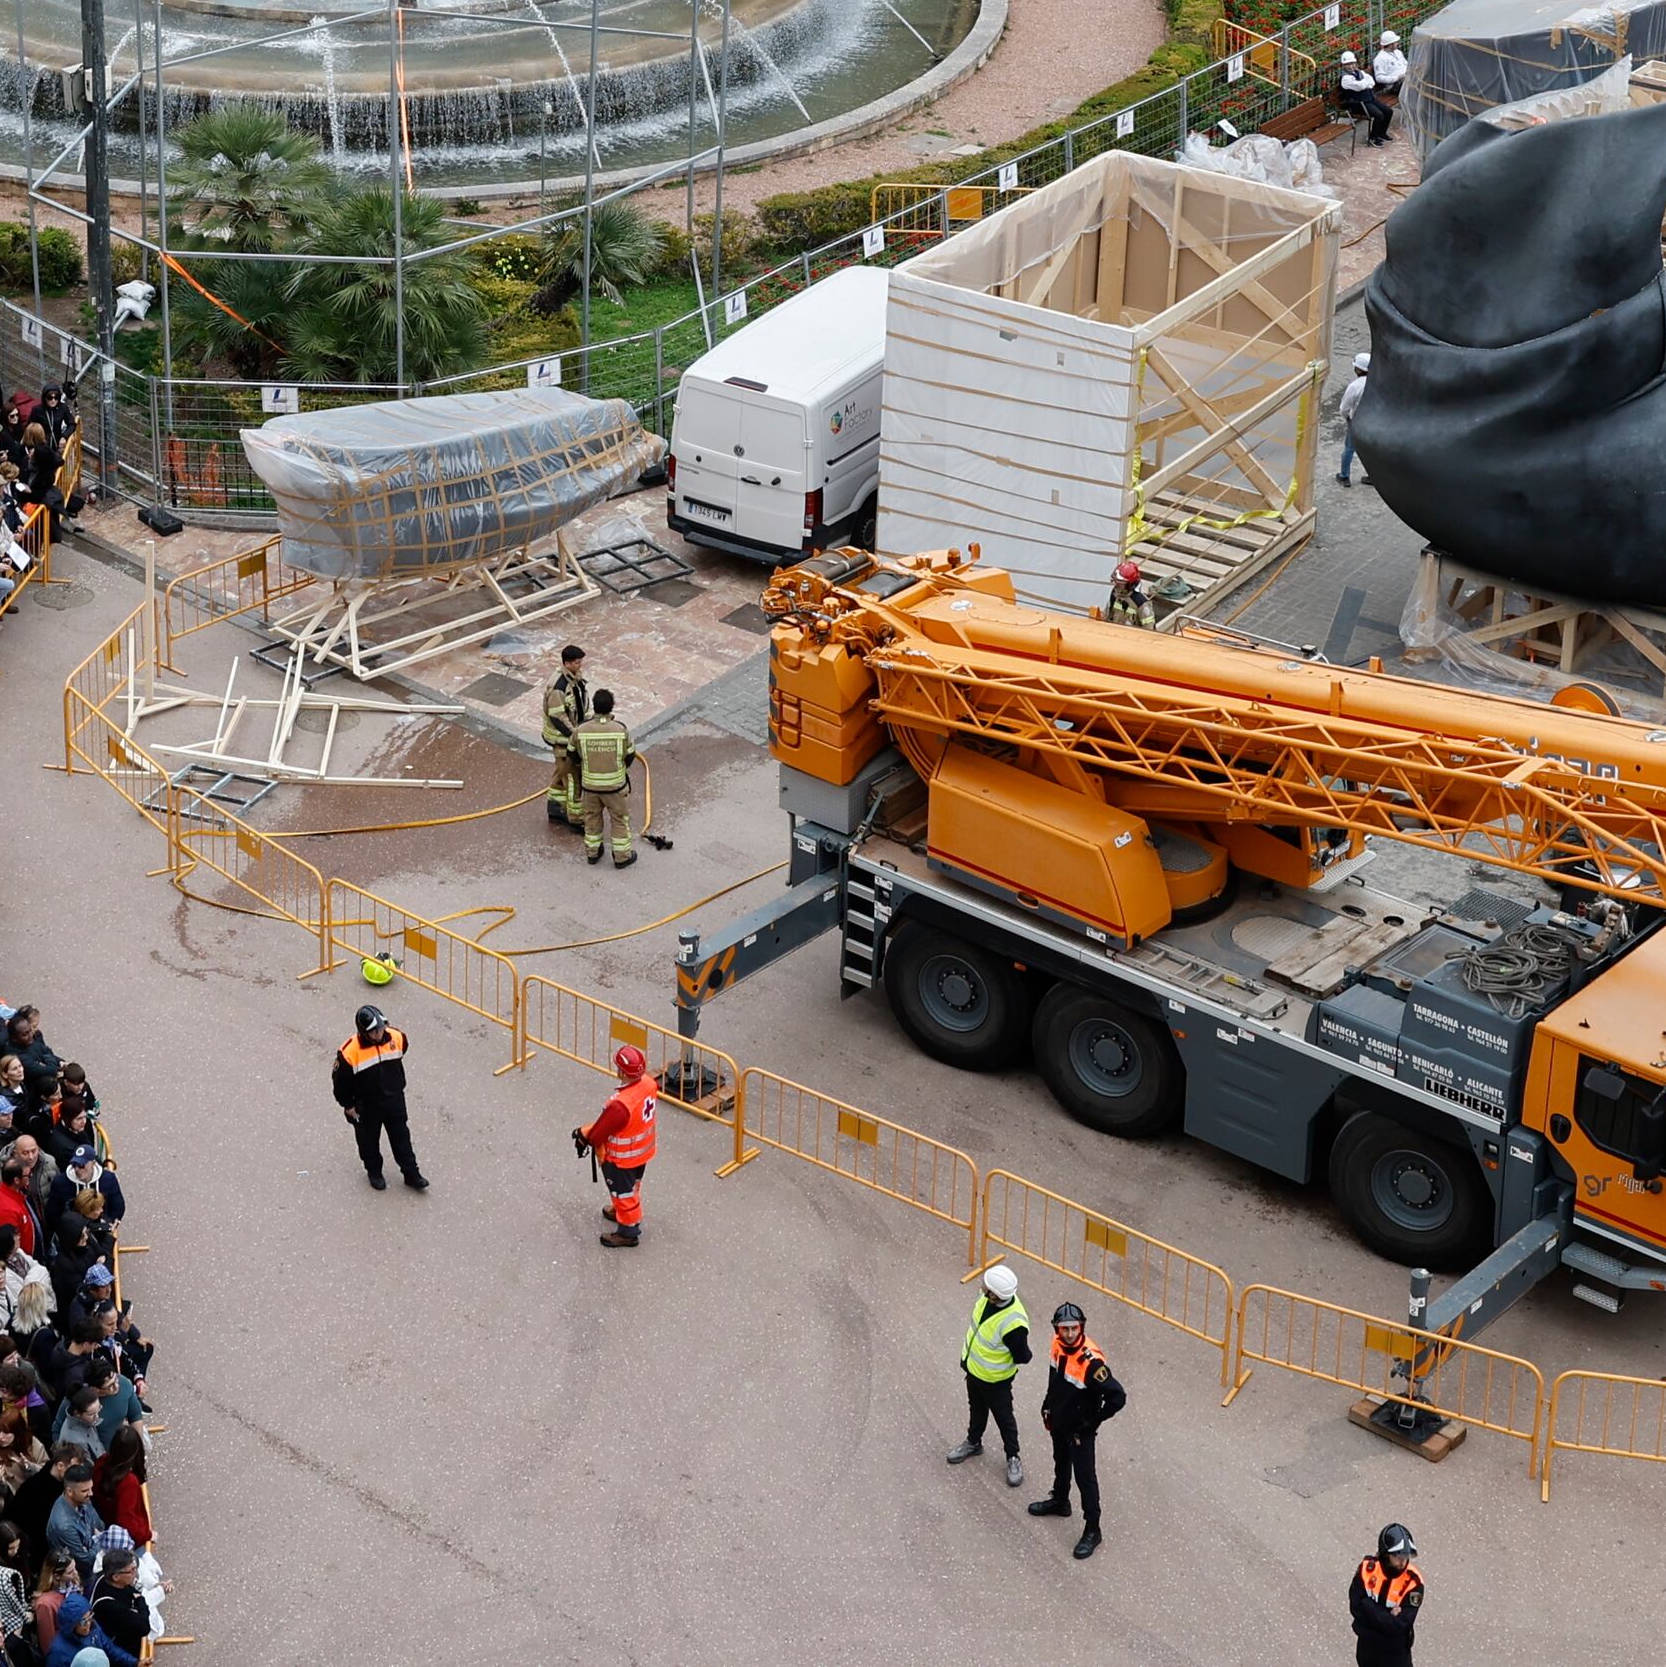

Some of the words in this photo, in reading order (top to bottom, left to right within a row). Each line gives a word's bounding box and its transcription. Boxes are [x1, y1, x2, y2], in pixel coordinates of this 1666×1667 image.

[844, 401, 856, 417] Art
[844, 407, 873, 430] Factory
[1412, 1003, 1459, 1028] TARRAGONA
[1467, 1025, 1509, 1048] CASTELLÓN
[1322, 1019, 1358, 1040] VALENCIA
[1367, 1037, 1403, 1058] SAGUNTO
[1412, 1055, 1454, 1079] BENICARLÓ
[1466, 1077, 1504, 1099] ALICANTE
[1425, 1078, 1506, 1122] LIEBHERR
